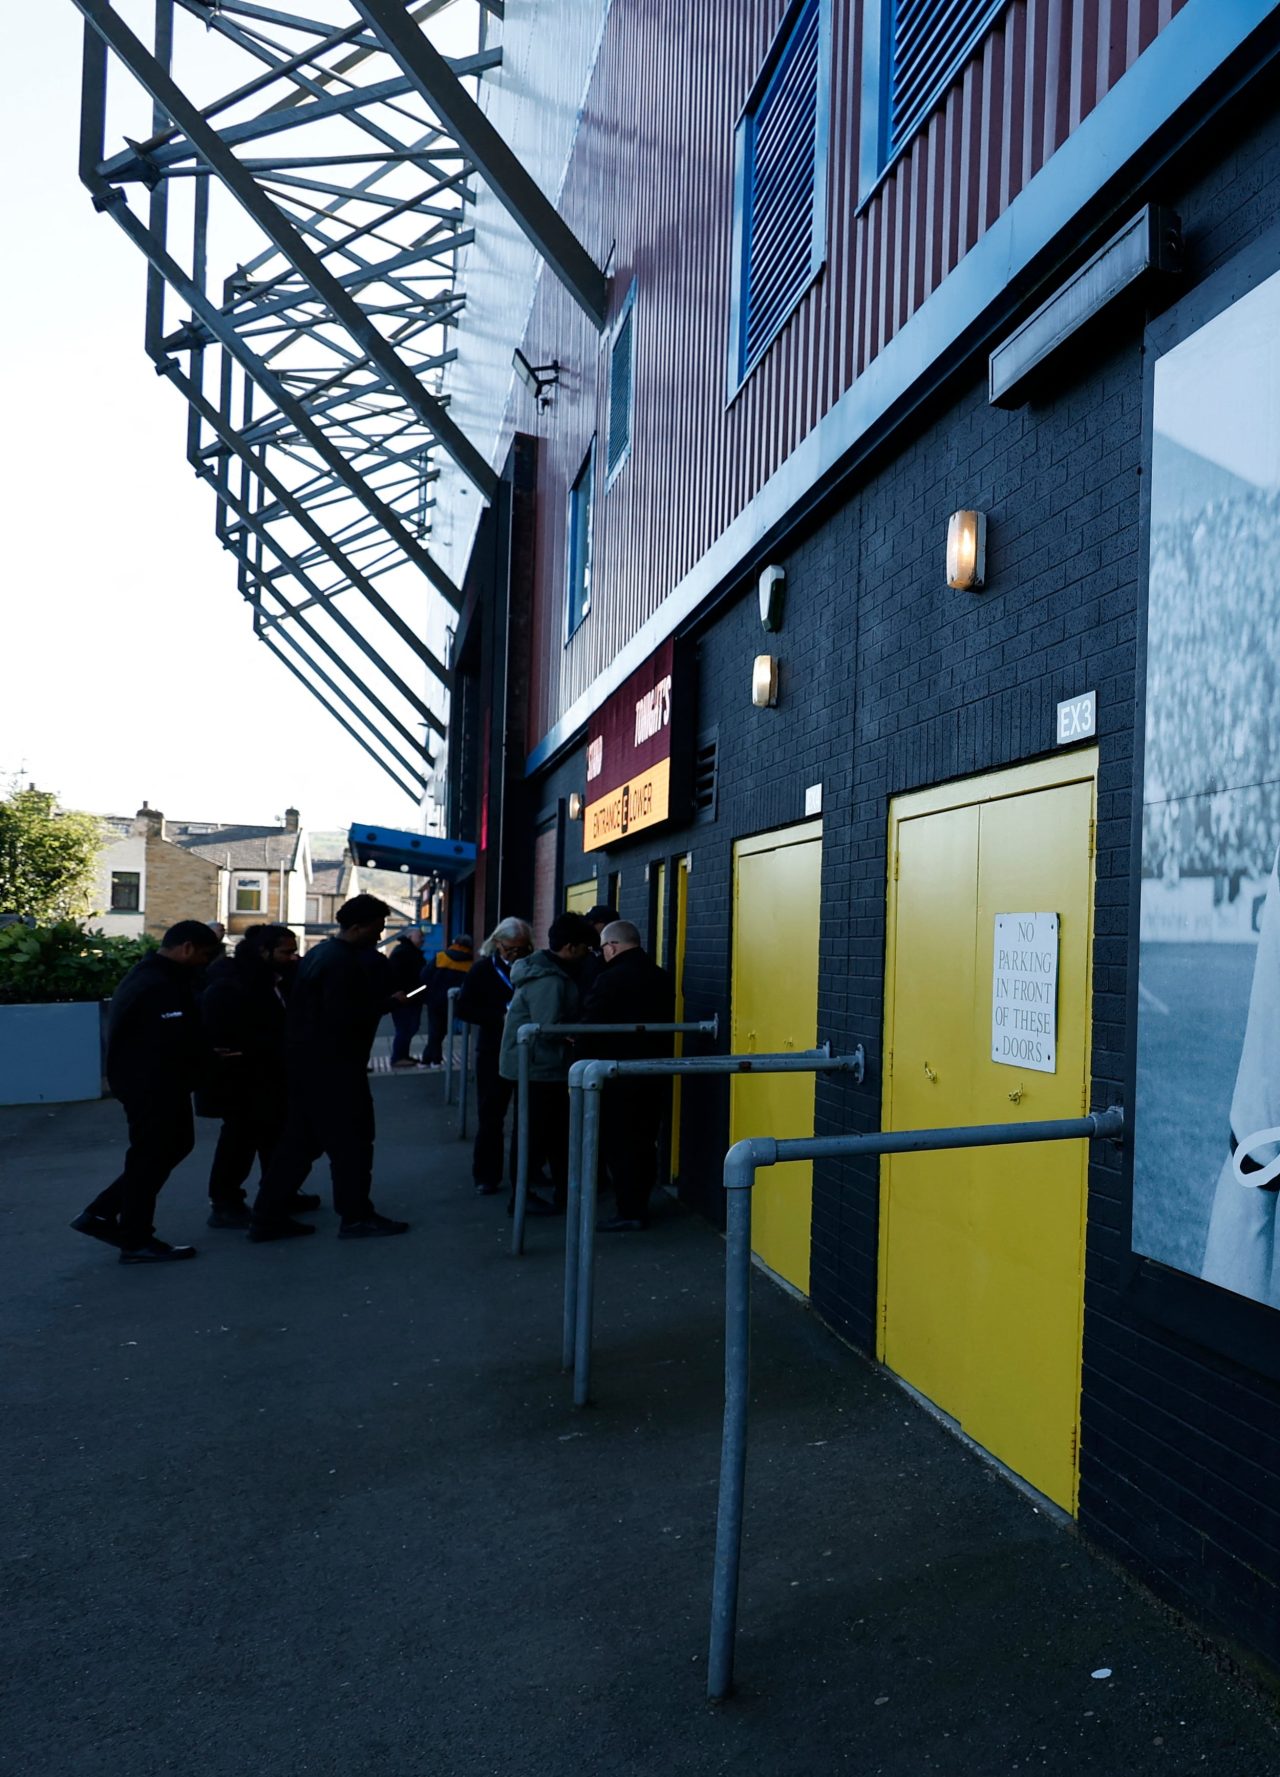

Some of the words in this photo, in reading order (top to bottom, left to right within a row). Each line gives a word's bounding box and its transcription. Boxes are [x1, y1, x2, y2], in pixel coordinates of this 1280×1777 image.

[1060, 699, 1092, 738] EX3
[592, 799, 621, 839] ENTRANCE
[629, 782, 652, 823] LOWER
[1017, 921, 1035, 943] NO
[998, 949, 1052, 974] PARKING
[996, 977, 1009, 999] IN
[1013, 979, 1053, 1004] FRONT
[995, 1006, 1010, 1027] OF
[1013, 1008, 1051, 1035] THESE
[1002, 1035, 1042, 1063] DOORS
